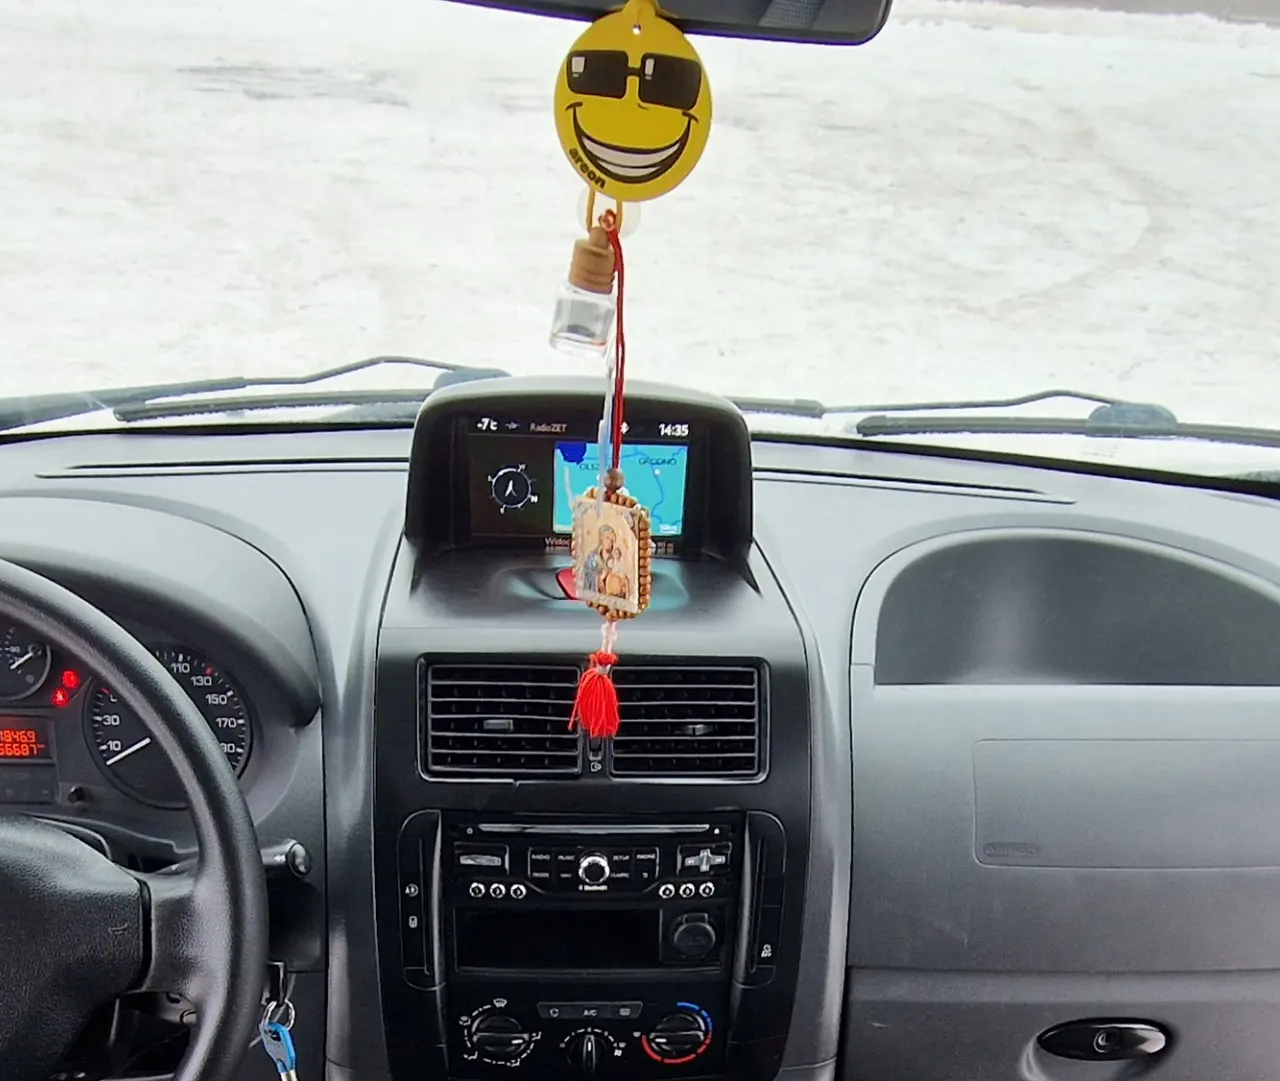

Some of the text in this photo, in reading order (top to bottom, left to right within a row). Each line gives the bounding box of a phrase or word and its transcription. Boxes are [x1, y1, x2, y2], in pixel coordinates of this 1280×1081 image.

[569, 148, 606, 189] areon
[659, 423, 689, 436] 14:35
[171, 663, 190, 673] 110
[190, 675, 212, 686] 130
[205, 694, 228, 705] 150
[102, 715, 120, 726] 30
[215, 717, 237, 728] 170
[106, 740, 122, 751] 10
[583, 1007, 598, 1017] A/C
